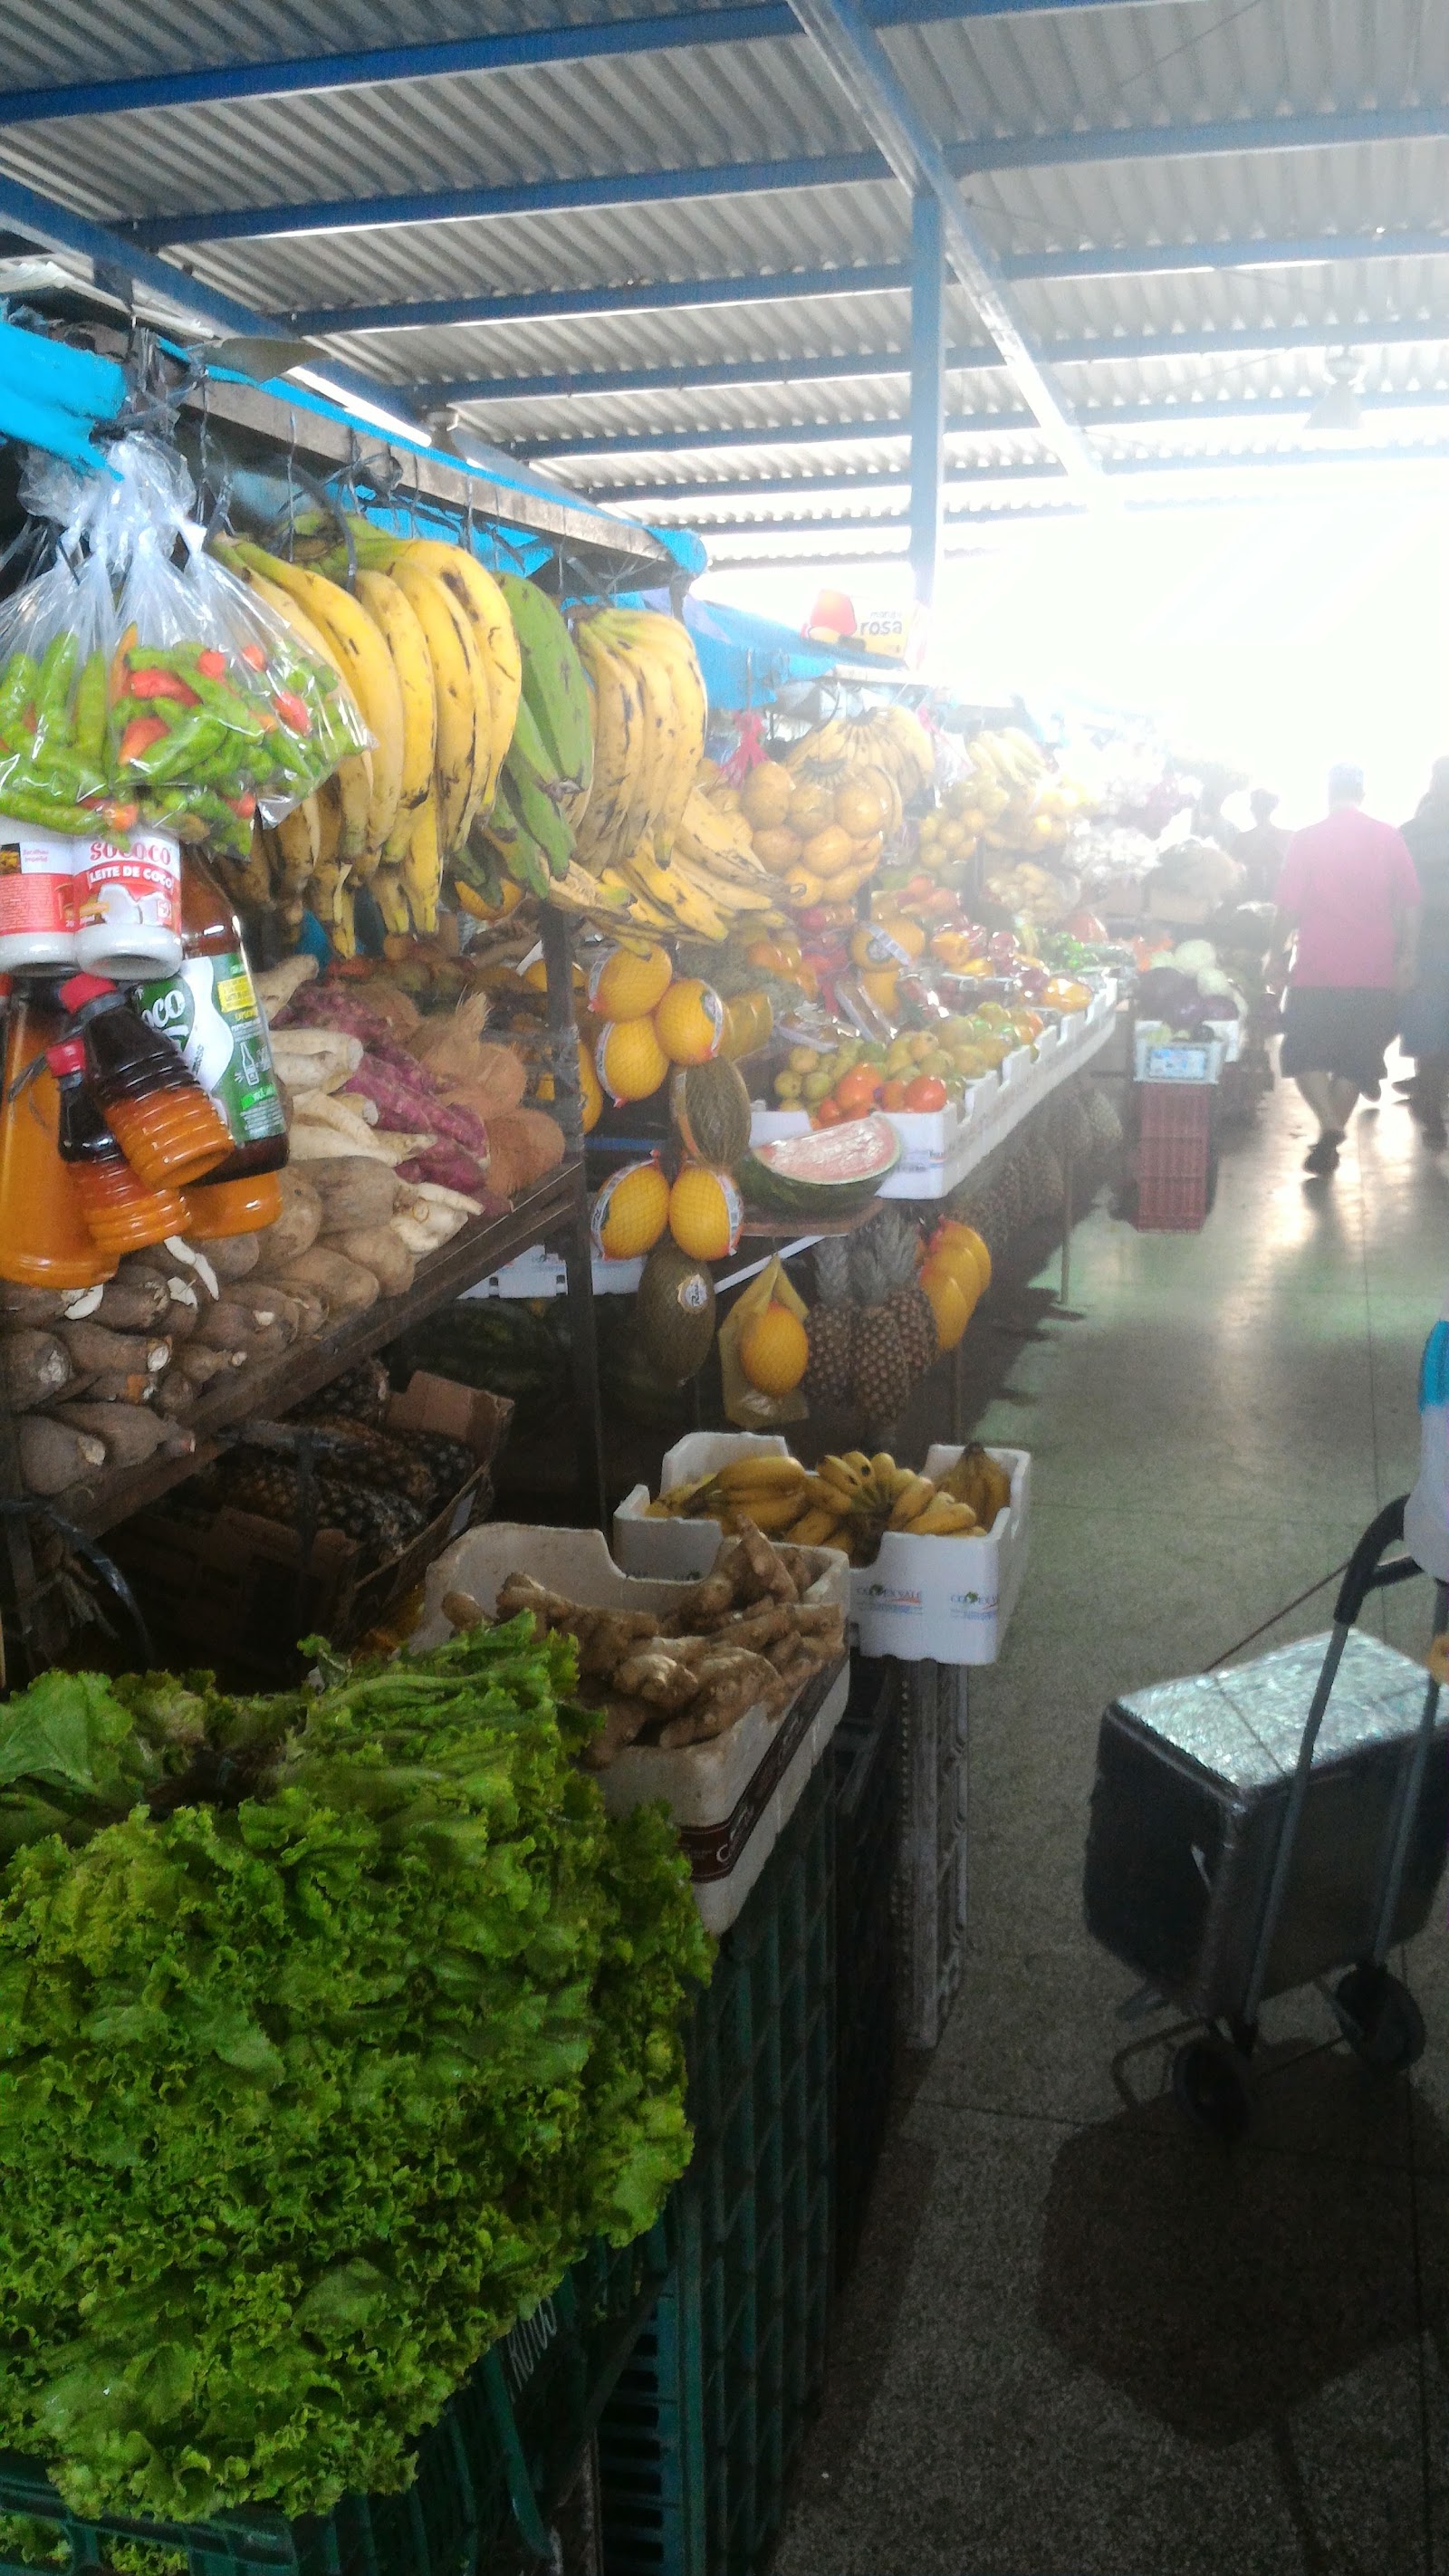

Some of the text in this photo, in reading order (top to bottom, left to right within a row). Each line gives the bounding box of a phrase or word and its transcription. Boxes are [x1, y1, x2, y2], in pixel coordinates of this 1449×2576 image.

[860, 620, 903, 636] rosa
[89, 865, 173, 889] LEITE DE COCO
